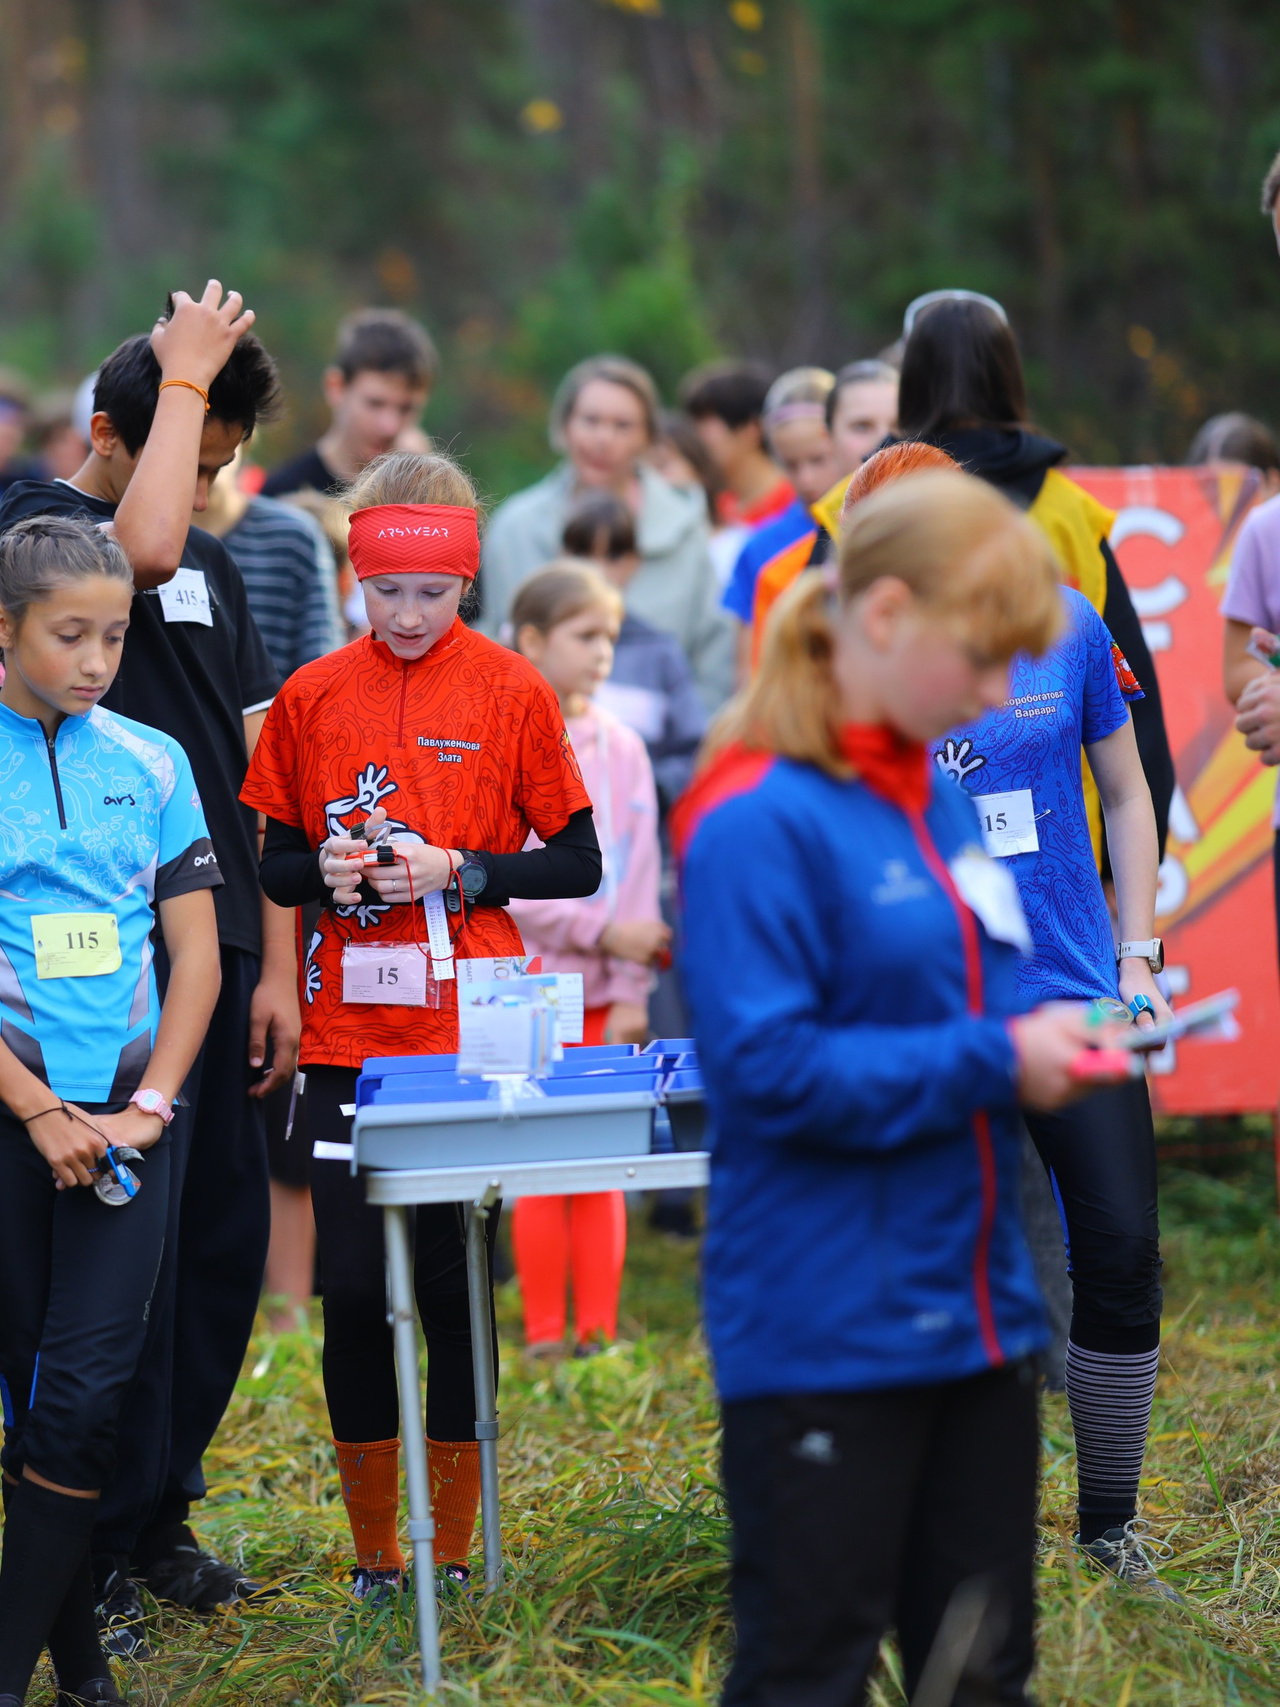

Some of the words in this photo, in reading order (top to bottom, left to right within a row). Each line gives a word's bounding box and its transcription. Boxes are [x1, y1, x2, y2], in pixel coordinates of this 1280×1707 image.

[377, 526, 449, 538] ARSWEAR
[175, 589, 198, 605] 415
[1015, 705, 1056, 718] Варвара
[417, 736, 481, 751] Павлуженкова
[437, 751, 462, 763] Злата
[103, 793, 136, 806] ars
[65, 931, 99, 949] 115
[376, 966, 399, 985] 15
